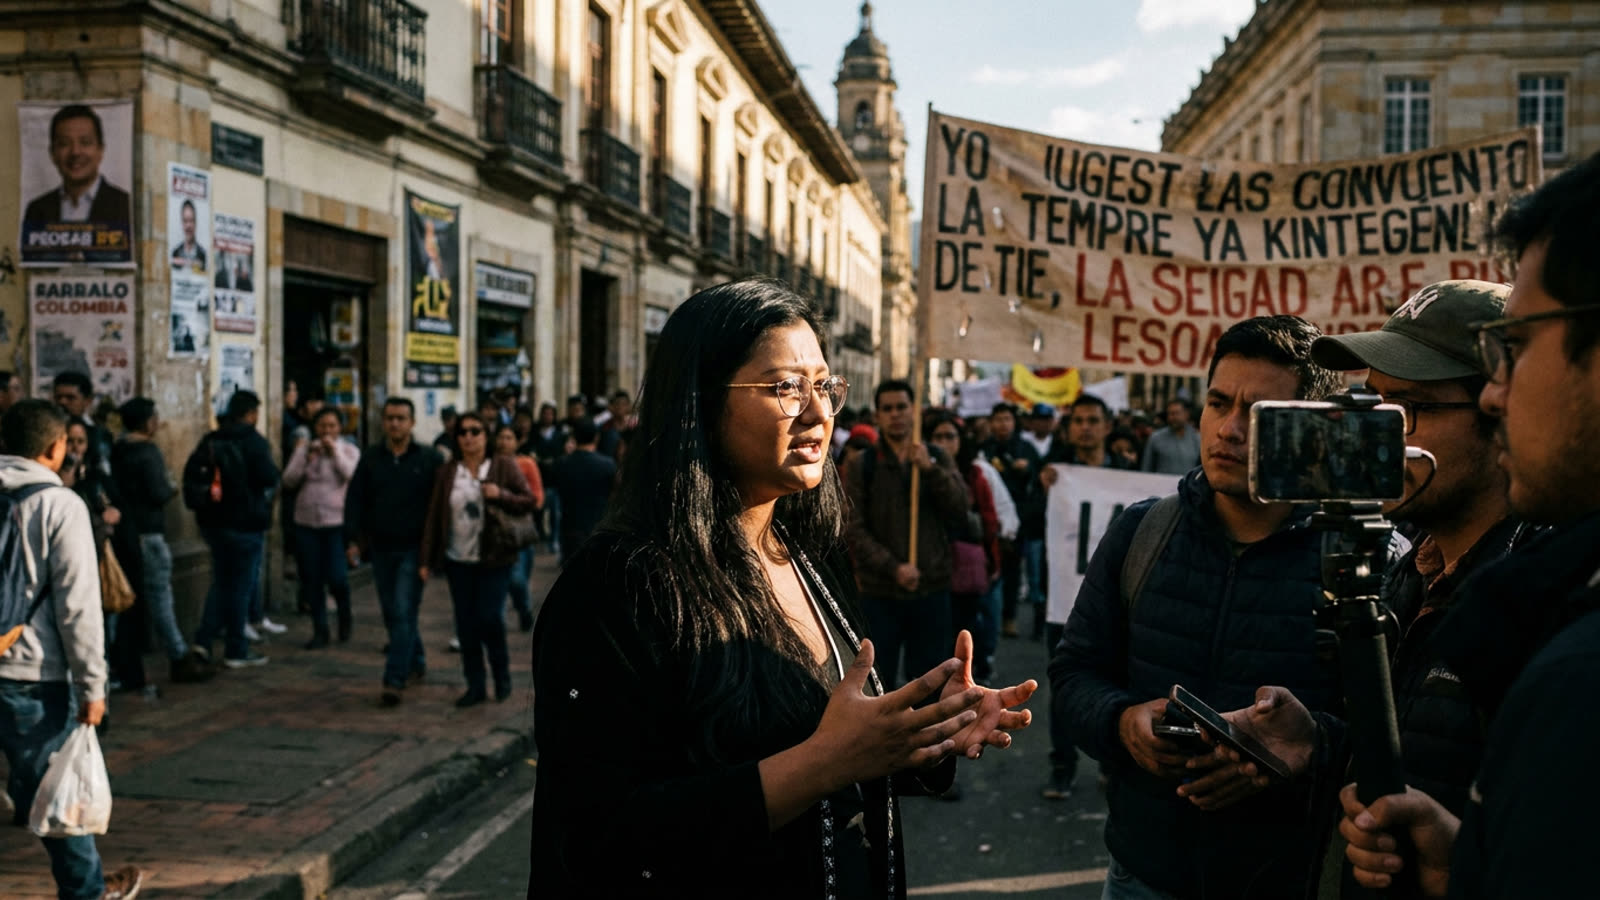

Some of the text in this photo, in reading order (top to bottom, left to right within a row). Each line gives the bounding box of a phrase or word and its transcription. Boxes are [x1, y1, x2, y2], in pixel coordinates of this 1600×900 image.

[940, 122, 990, 181] YO
[937, 182, 986, 237] LA
[1021, 192, 1174, 259] TEMPRE
[1193, 216, 1248, 262] YA
[34, 299, 128, 315] COLOMBIA
[934, 239, 984, 294] DE
[1074, 252, 1134, 312] LA
[1151, 261, 1308, 319] SEIGAD
